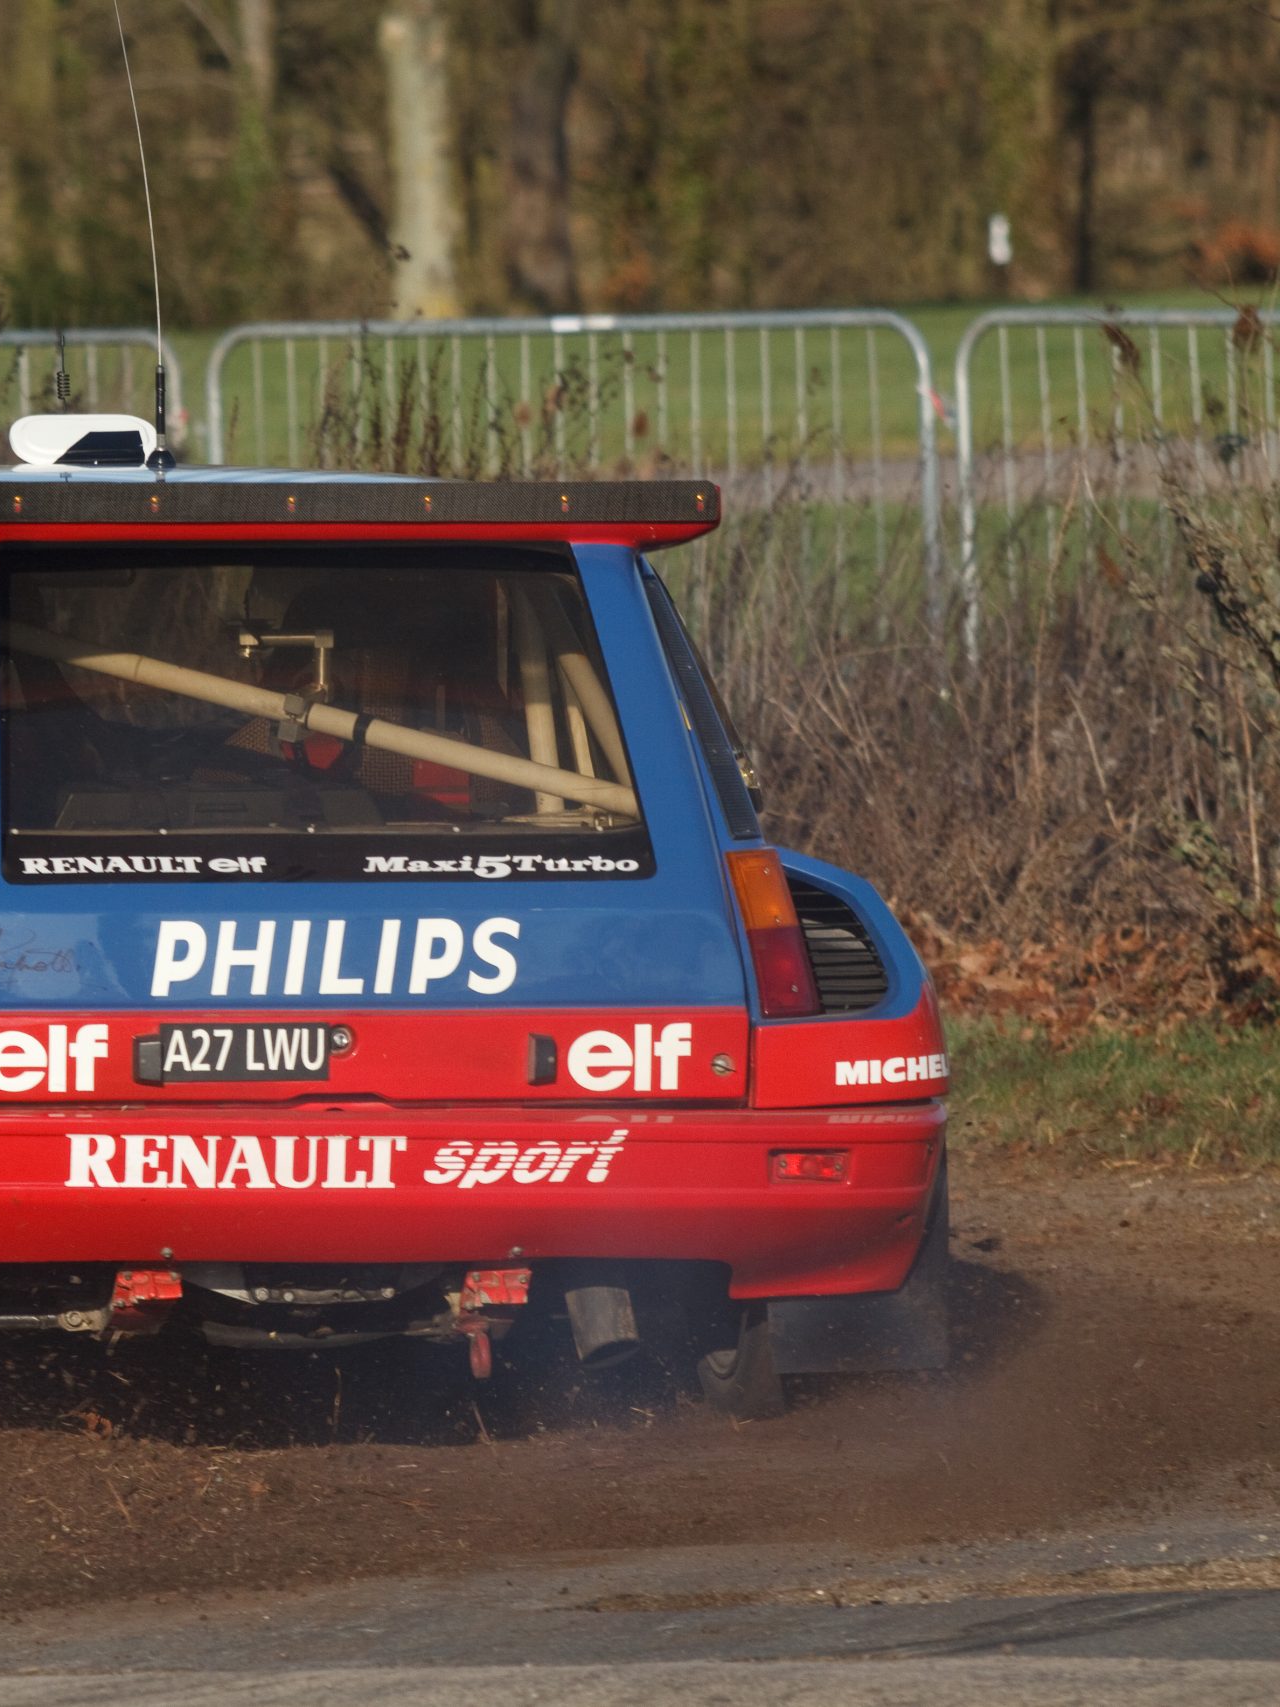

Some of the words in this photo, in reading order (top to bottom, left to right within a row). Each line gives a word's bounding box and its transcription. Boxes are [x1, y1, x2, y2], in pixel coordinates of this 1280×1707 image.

[20, 856, 203, 874] RENAULT
[207, 856, 267, 873] elf
[150, 917, 520, 996] PHILIPS
[163, 1029, 233, 1072] A27
[245, 1028, 325, 1071] LWU
[567, 1023, 692, 1092] elf
[65, 1133, 407, 1189] RENAULT
[423, 1128, 629, 1189] sport
